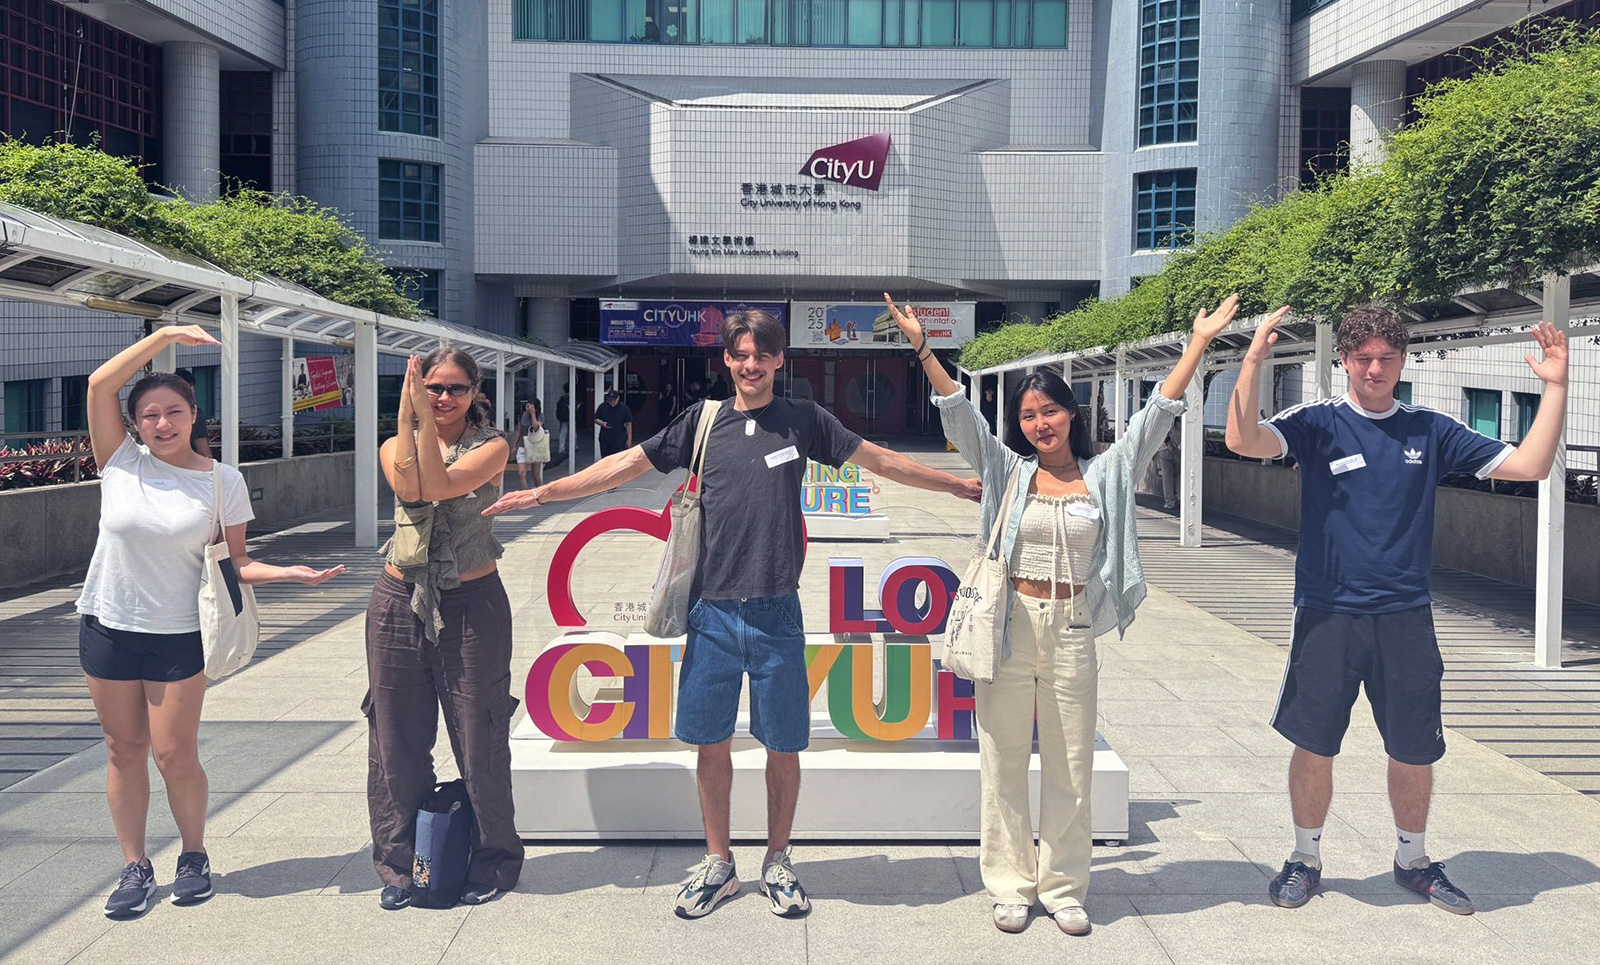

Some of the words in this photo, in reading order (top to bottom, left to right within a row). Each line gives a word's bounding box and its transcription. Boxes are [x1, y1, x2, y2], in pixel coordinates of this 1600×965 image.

[810, 157, 874, 184] CityU
[741, 183, 825, 195] 香港城市大學
[740, 197, 758, 209] City
[760, 197, 800, 209] University
[802, 198, 812, 207] of
[813, 199, 837, 210] Hong
[839, 199, 861, 210] Kong
[688, 248, 709, 256] Yeung
[773, 249, 799, 258] Building
[643, 310, 706, 322] CITYUHK
[807, 307, 824, 318] 20
[807, 319, 824, 330] 25
[803, 462, 860, 483] ING
[829, 558, 961, 635] LO
[614, 602, 651, 611] 香港城
[613, 613, 631, 623] City
